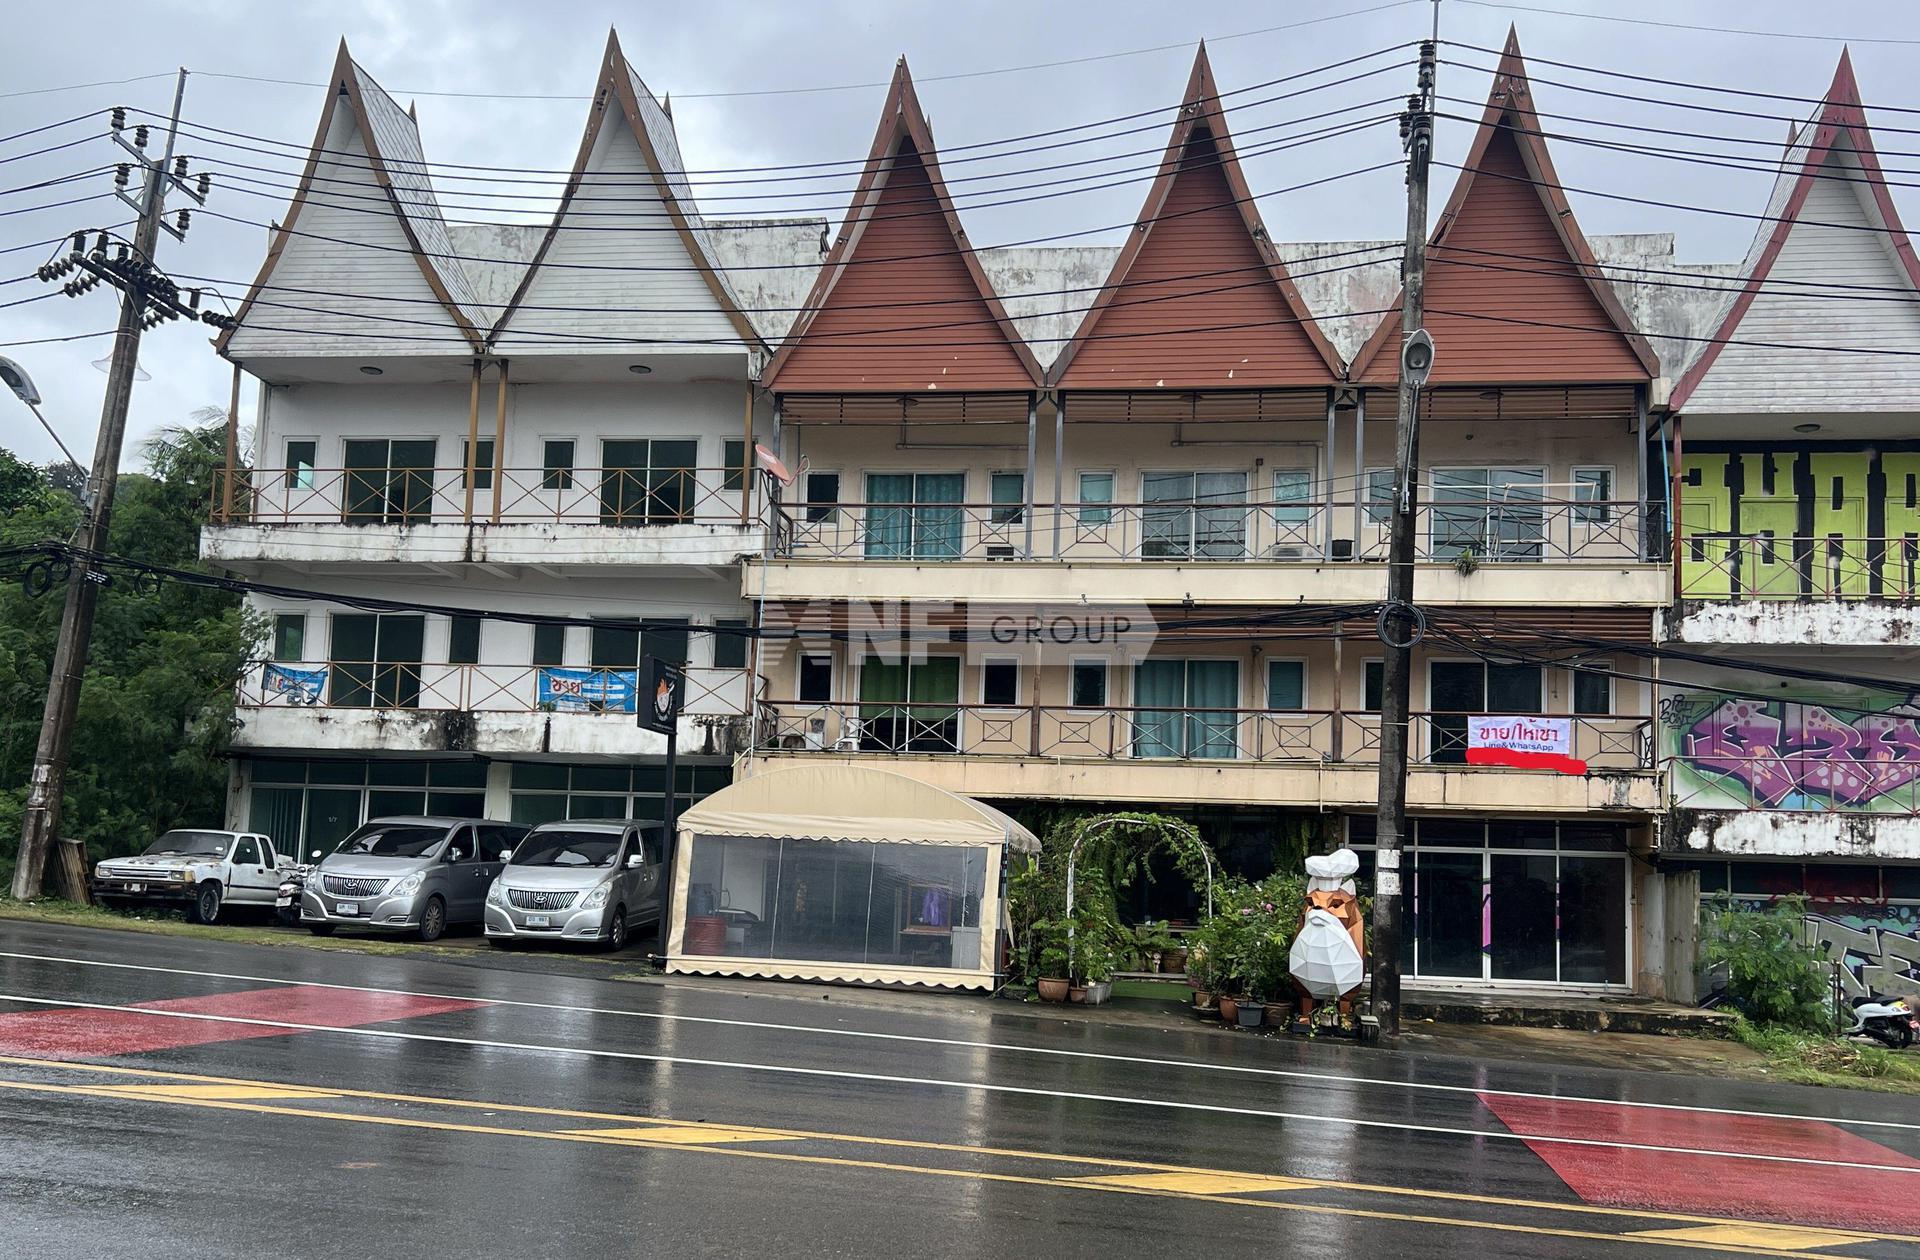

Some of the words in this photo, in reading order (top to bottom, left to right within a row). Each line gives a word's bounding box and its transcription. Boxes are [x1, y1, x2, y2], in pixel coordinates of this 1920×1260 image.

[1480, 718, 1558, 742] ขาย/ให้เช่า
[1484, 742, 1554, 751] Line&WhatsApp
